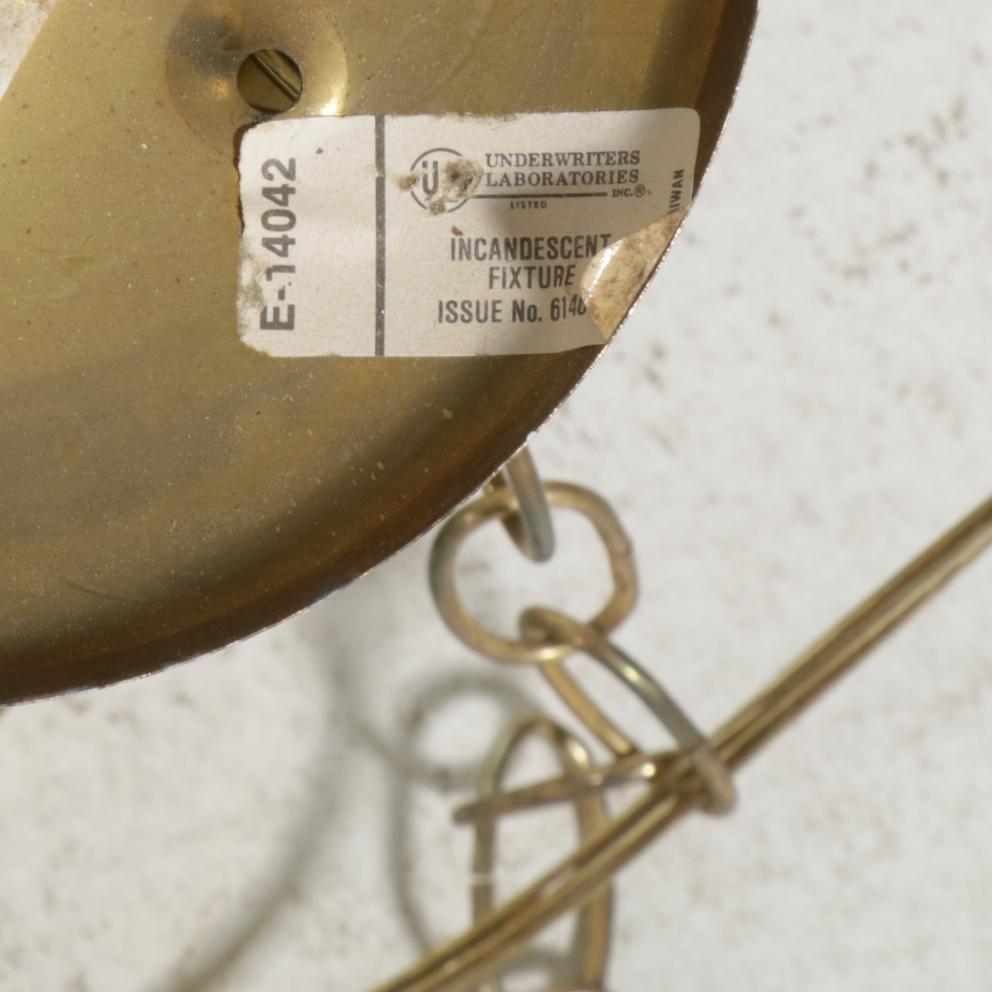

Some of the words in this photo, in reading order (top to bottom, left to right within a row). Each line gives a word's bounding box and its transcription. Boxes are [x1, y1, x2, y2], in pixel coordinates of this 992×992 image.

[484, 150, 641, 168] UNDERWRITERS
[484, 169, 640, 187] LABORATORIES
[510, 200, 548, 209] LISTED
[259, 157, 297, 331] E-14042
[450, 234, 612, 261] INCANDESCENT
[488, 264, 577, 290] FIXTURE
[438, 299, 503, 324] ISSUE
[511, 299, 543, 323] No.
